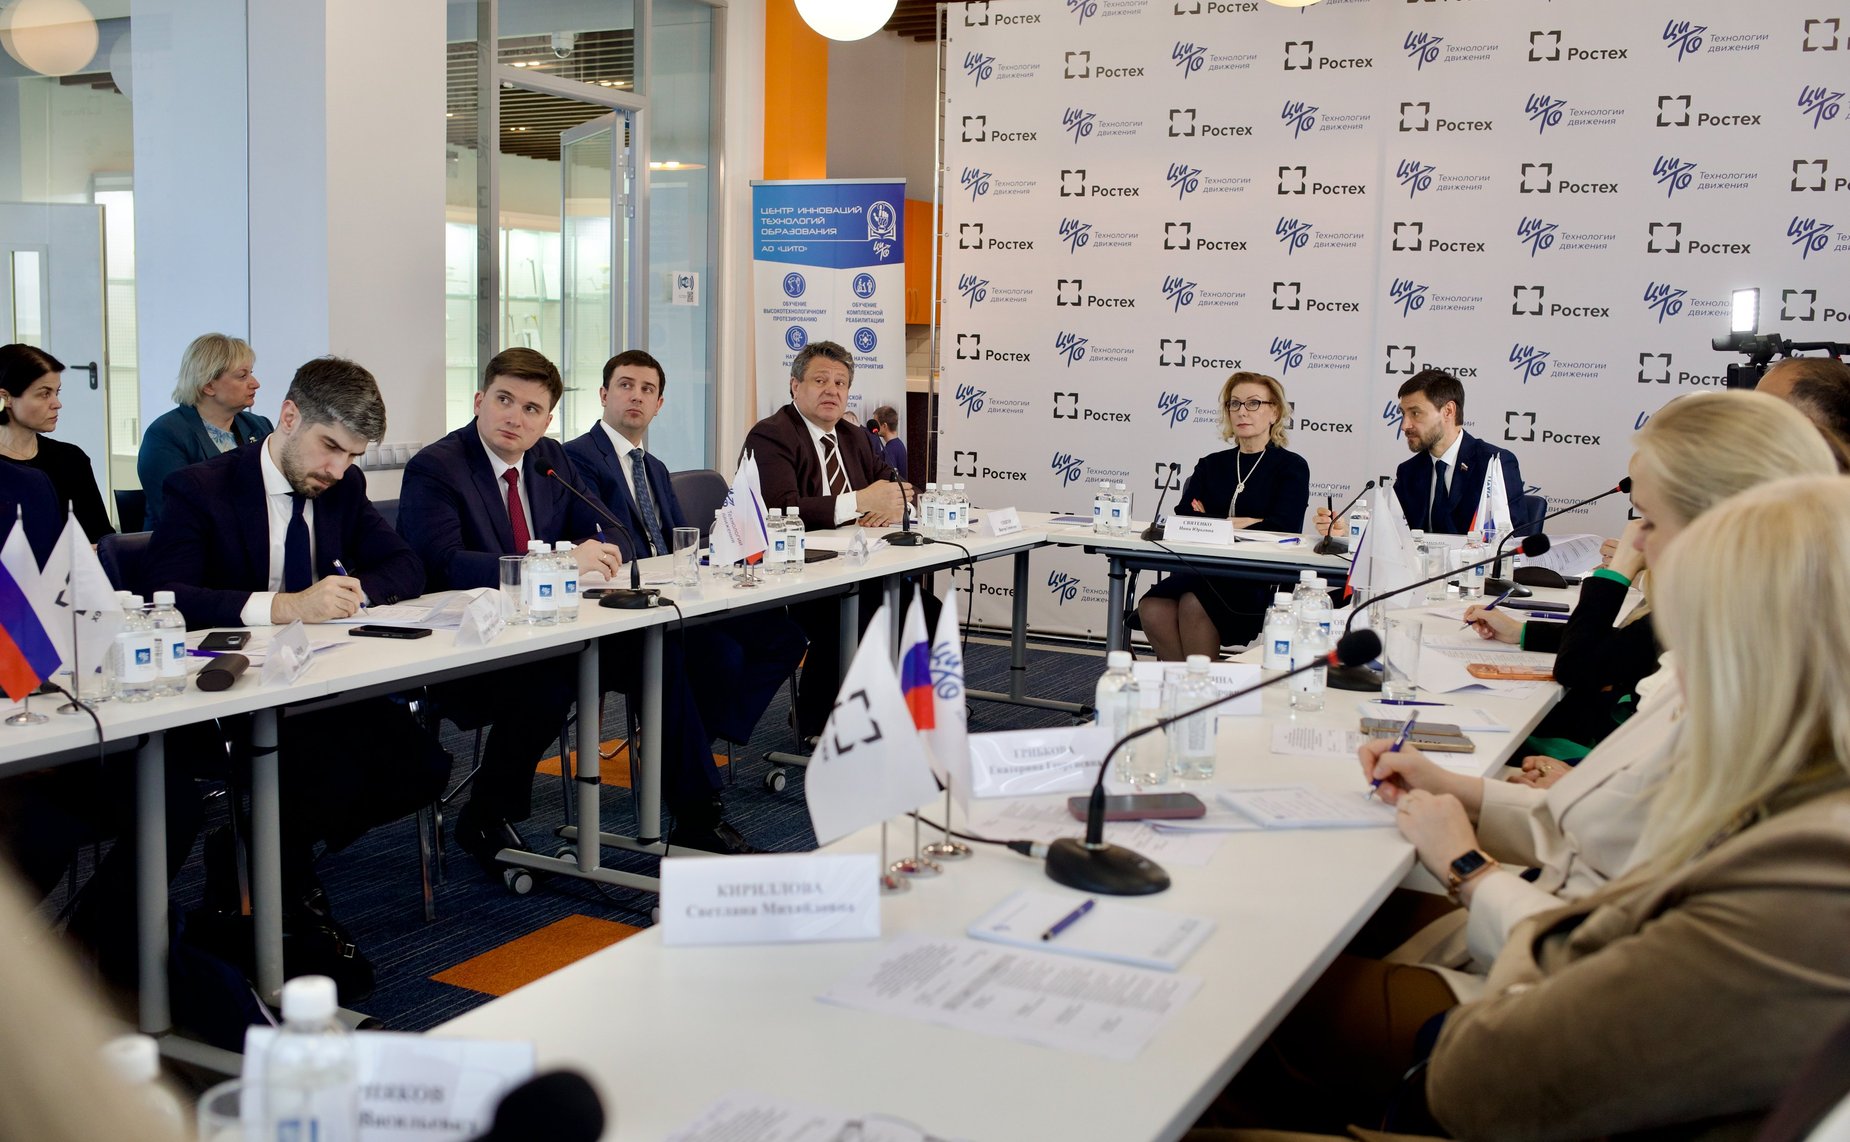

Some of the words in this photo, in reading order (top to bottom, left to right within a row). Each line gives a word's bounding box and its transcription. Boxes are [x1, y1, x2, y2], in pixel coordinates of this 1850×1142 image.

[1208, 2, 1258, 13] Ростех
[995, 14, 1040, 25] Ростех
[1711, 34, 1768, 42] Технологии
[1568, 48, 1627, 60] Ростех
[1708, 45, 1759, 53] движения
[1320, 58, 1372, 69] Ростех
[1096, 67, 1144, 78] Ростех
[1437, 119, 1492, 131] Ростех
[1698, 113, 1760, 126] Ростех
[992, 131, 1036, 141] Ростех
[1202, 125, 1252, 136] Ростех
[1092, 186, 1139, 196] Ростех
[1313, 183, 1365, 194] Ростех
[1559, 181, 1618, 193] Ростех
[798, 206, 862, 214] ИННОВАЦИЙ
[761, 217, 825, 225] ТЕХНОЛОГИЙ
[1562, 232, 1615, 240] Технологии
[989, 239, 1033, 249] Ростех
[1197, 239, 1246, 250] Ростех
[1430, 240, 1484, 252] Ростех
[1689, 241, 1750, 254] Ростех
[1088, 296, 1134, 307] Ростех
[1432, 294, 1482, 302] Технологии
[1690, 298, 1731, 307] Техноло
[1307, 299, 1359, 311] Ростех
[1551, 304, 1609, 317] Ростех
[986, 350, 1030, 361] Ростех
[1310, 352, 1357, 360] Технологии
[1192, 356, 1241, 368] Ростех
[1552, 360, 1606, 370] Технологии
[1679, 372, 1727, 386] Росте
[989, 398, 1029, 406] Технологии
[1084, 409, 1130, 422] Ростех
[1301, 419, 1352, 432] Ростех
[1543, 431, 1600, 445] Ростех
[983, 468, 1026, 480] Ростех
[1086, 467, 1129, 479] Технологии
[980, 584, 1016, 596] Росте
[717, 883, 824, 898] КИРИЛЛОВА
[686, 904, 758, 918] Светлана
